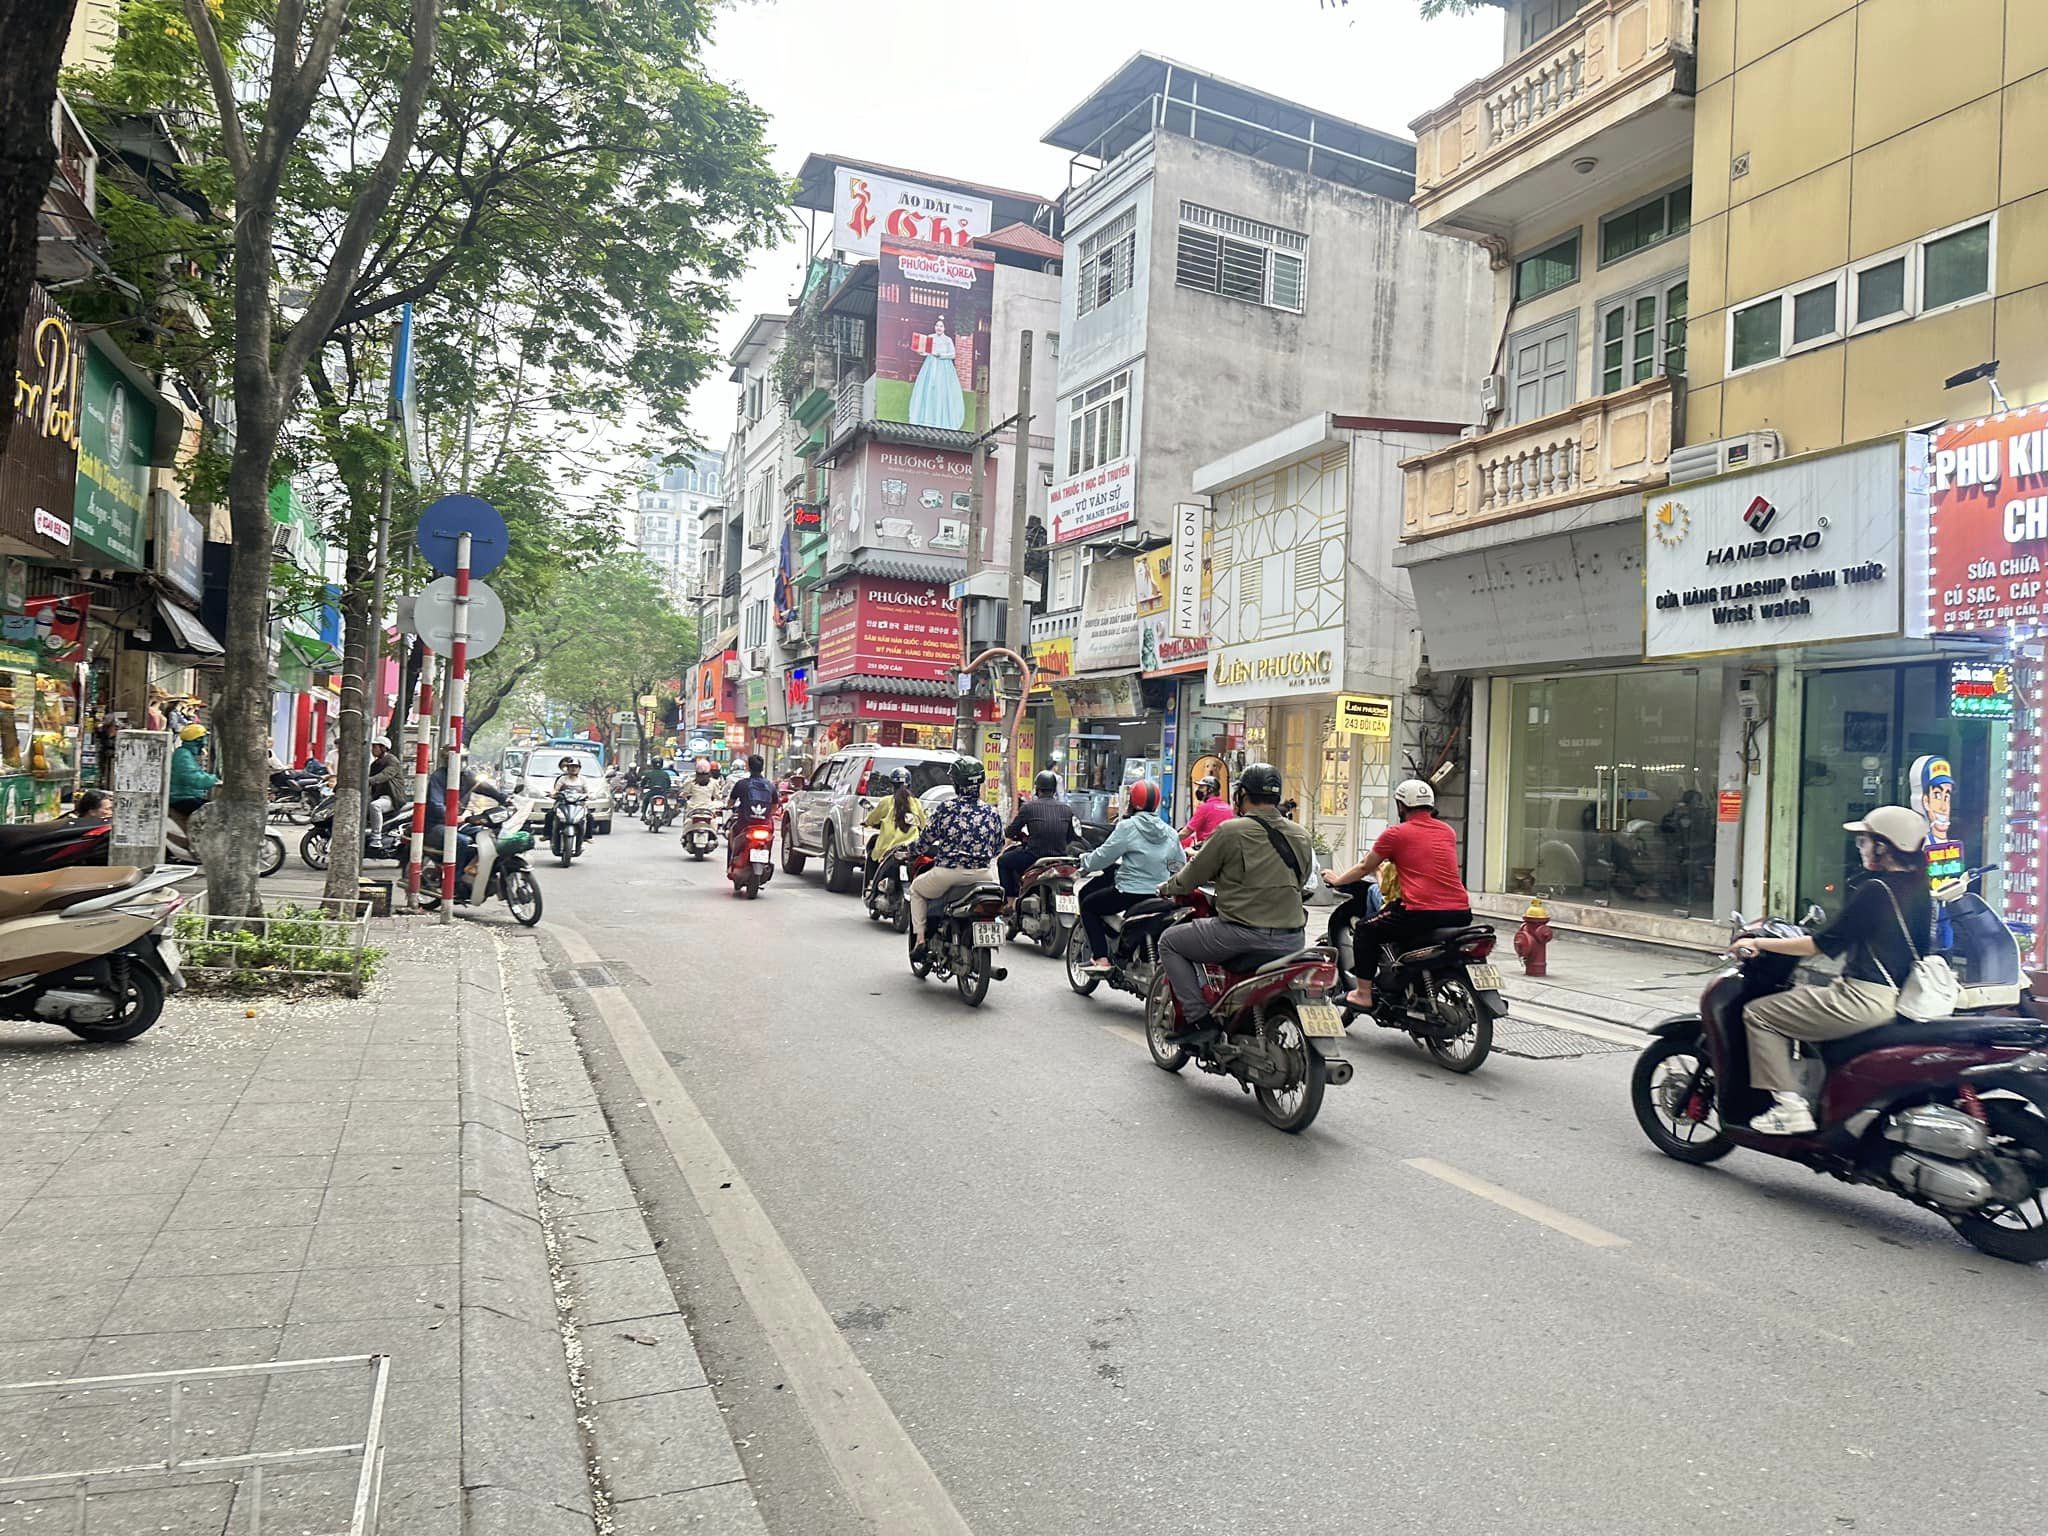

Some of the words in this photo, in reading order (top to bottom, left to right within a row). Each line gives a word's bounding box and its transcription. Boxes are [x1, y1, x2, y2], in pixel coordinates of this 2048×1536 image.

[946, 264, 975, 280] KOREA
[1935, 439, 1999, 492] PHỤ
[2003, 496, 2048, 544] CH
[1183, 511, 1195, 573] SALON
[1706, 531, 1821, 566] HANBORO
[1967, 556, 1996, 580] SỬA
[2000, 553, 2040, 577] CHỮA
[868, 591, 929, 607] PHƯƠNG
[1655, 589, 1680, 610] CỬA
[1682, 585, 1718, 606] HÀNG
[1720, 577, 1787, 601] FLAGSHIP
[1791, 568, 1836, 592] CHÍNH
[1841, 560, 1886, 586] THỨC
[2010, 577, 2041, 600] CÁP
[1181, 585, 1193, 630] HAIR
[1712, 604, 1753, 625] Wrist
[1760, 596, 1811, 619] watch
[1977, 608, 1994, 620] 237
[1257, 649, 1333, 680] PHƯƠNG
[1289, 680, 1304, 688] HAIR
[1309, 677, 1331, 687] SALON
[1344, 718, 1358, 729] 243
